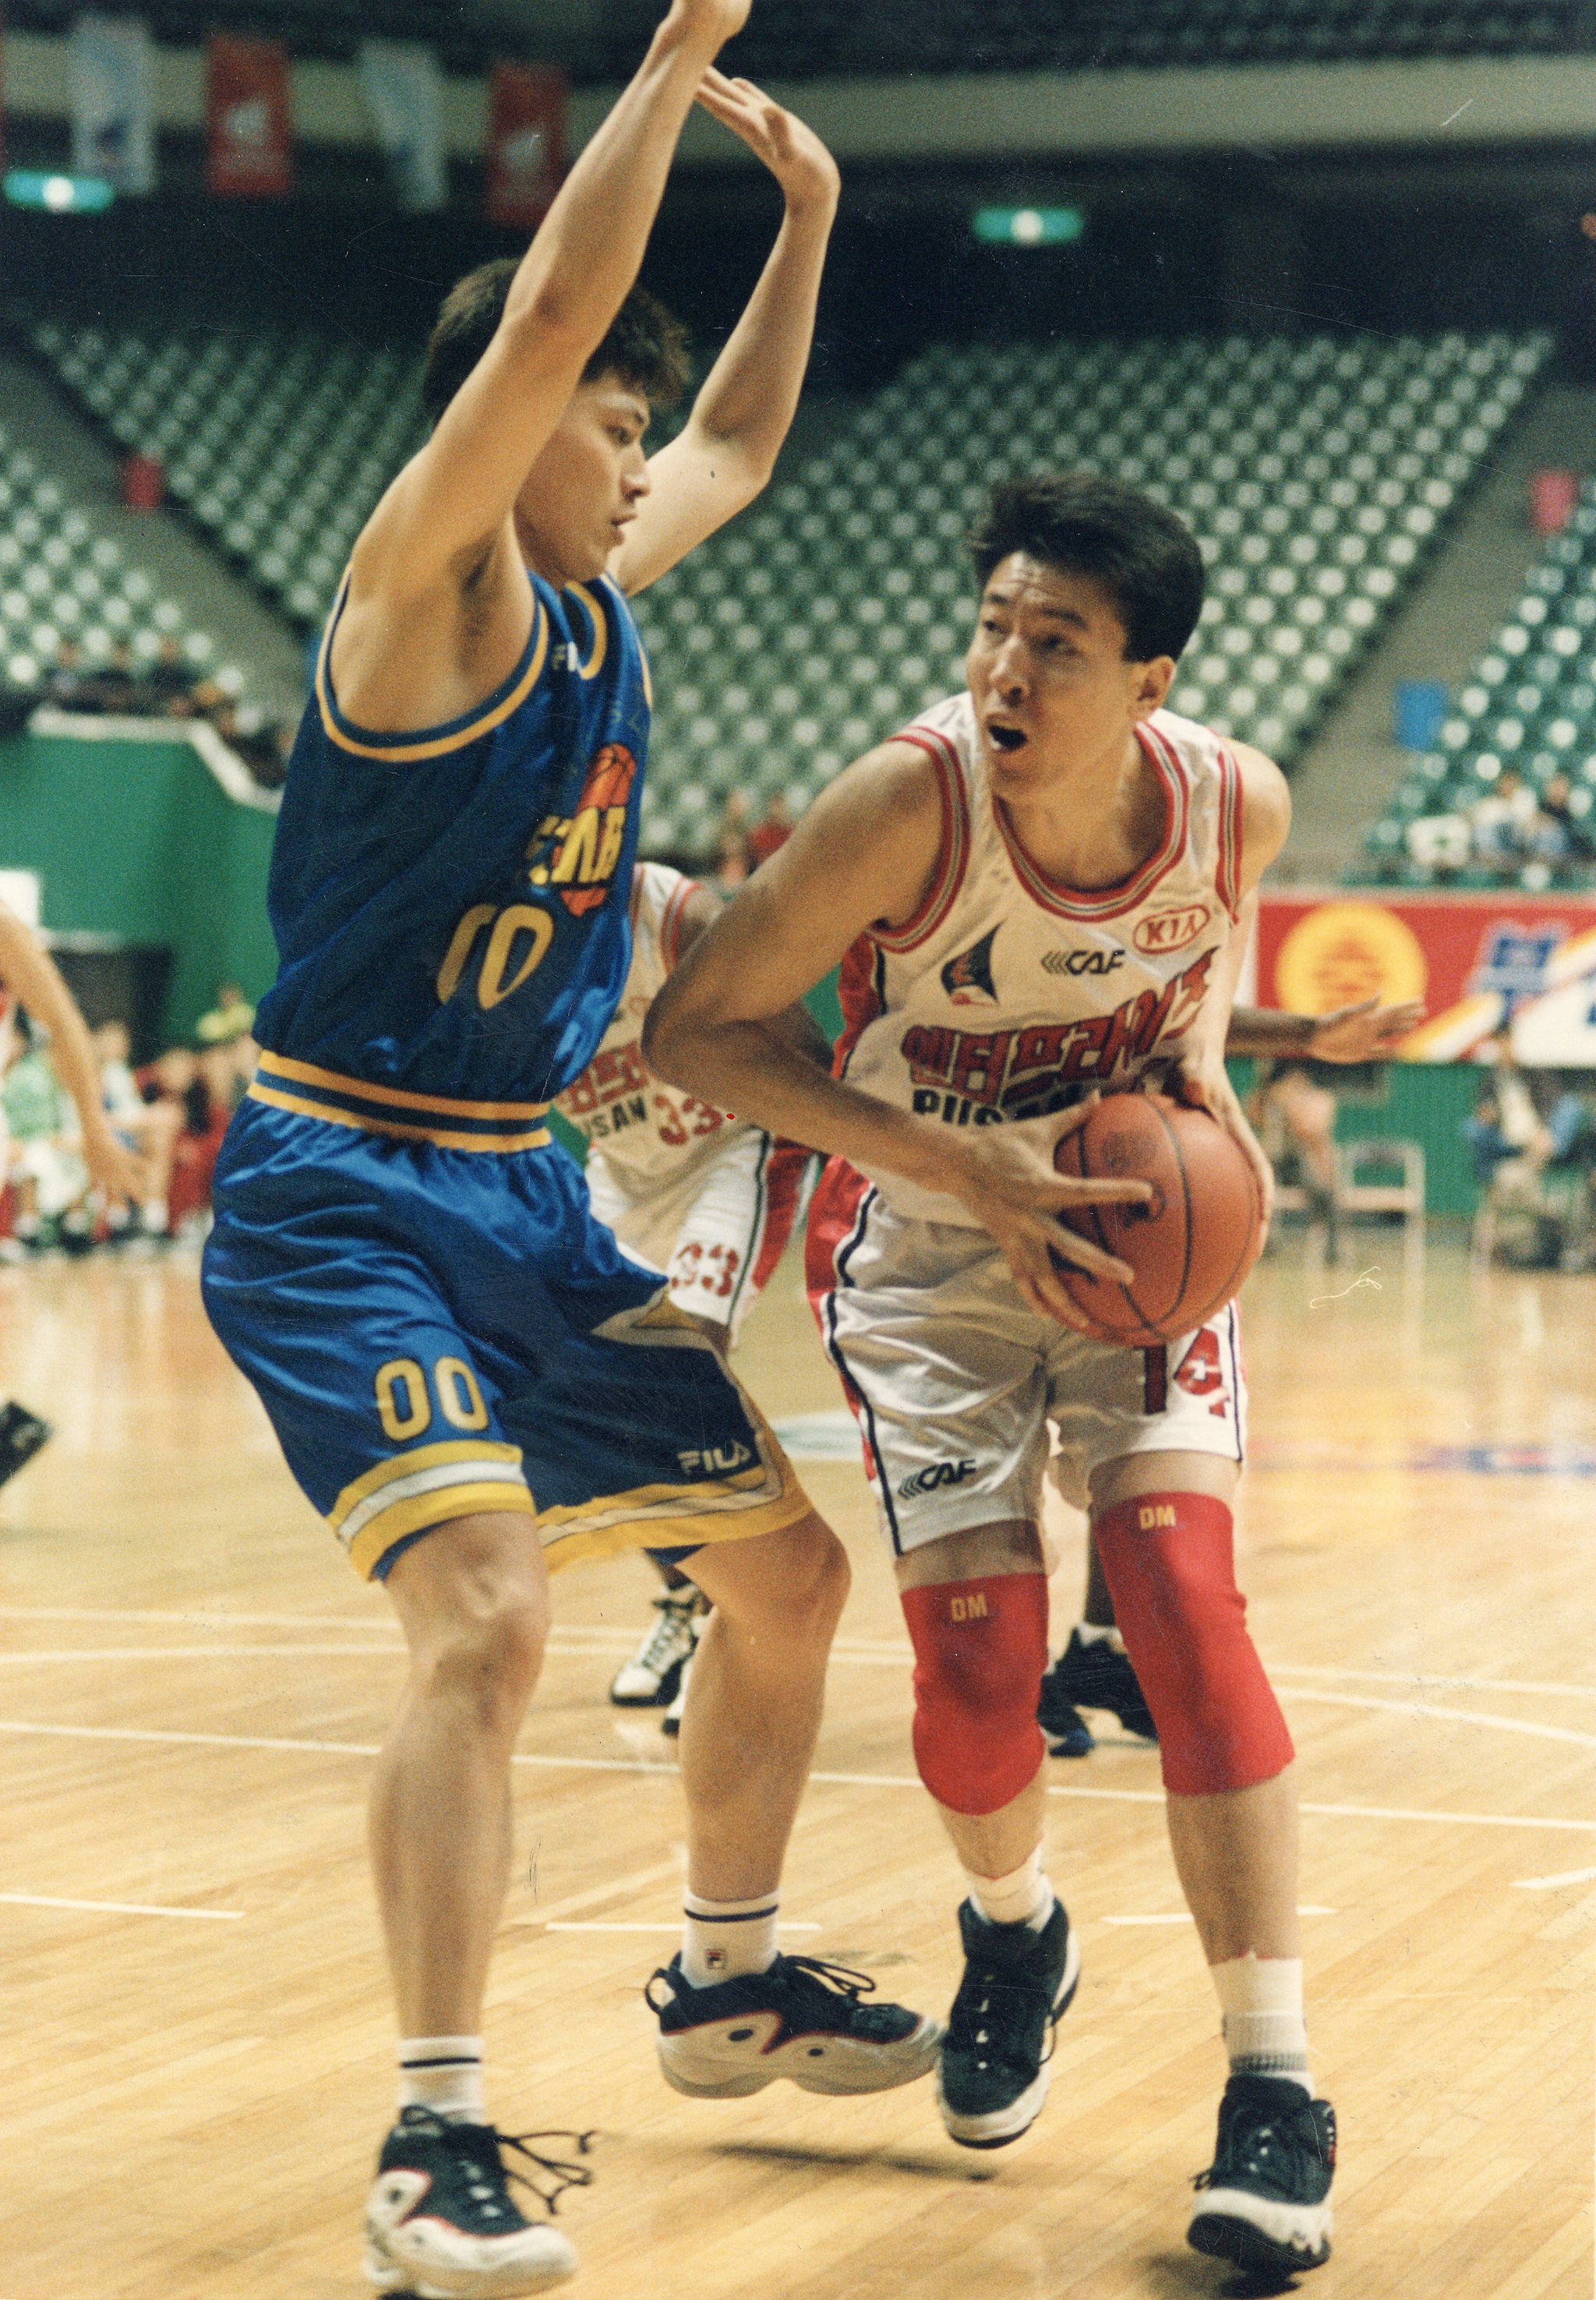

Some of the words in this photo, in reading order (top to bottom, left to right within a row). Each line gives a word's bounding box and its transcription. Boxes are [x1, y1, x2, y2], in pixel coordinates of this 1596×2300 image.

[1146, 914, 1198, 946] KIA
[374, 1356, 490, 1442] 00
[677, 1440, 752, 1475] FILA
[1139, 1504, 1177, 1530] DM
[950, 1595, 988, 1623] DM
